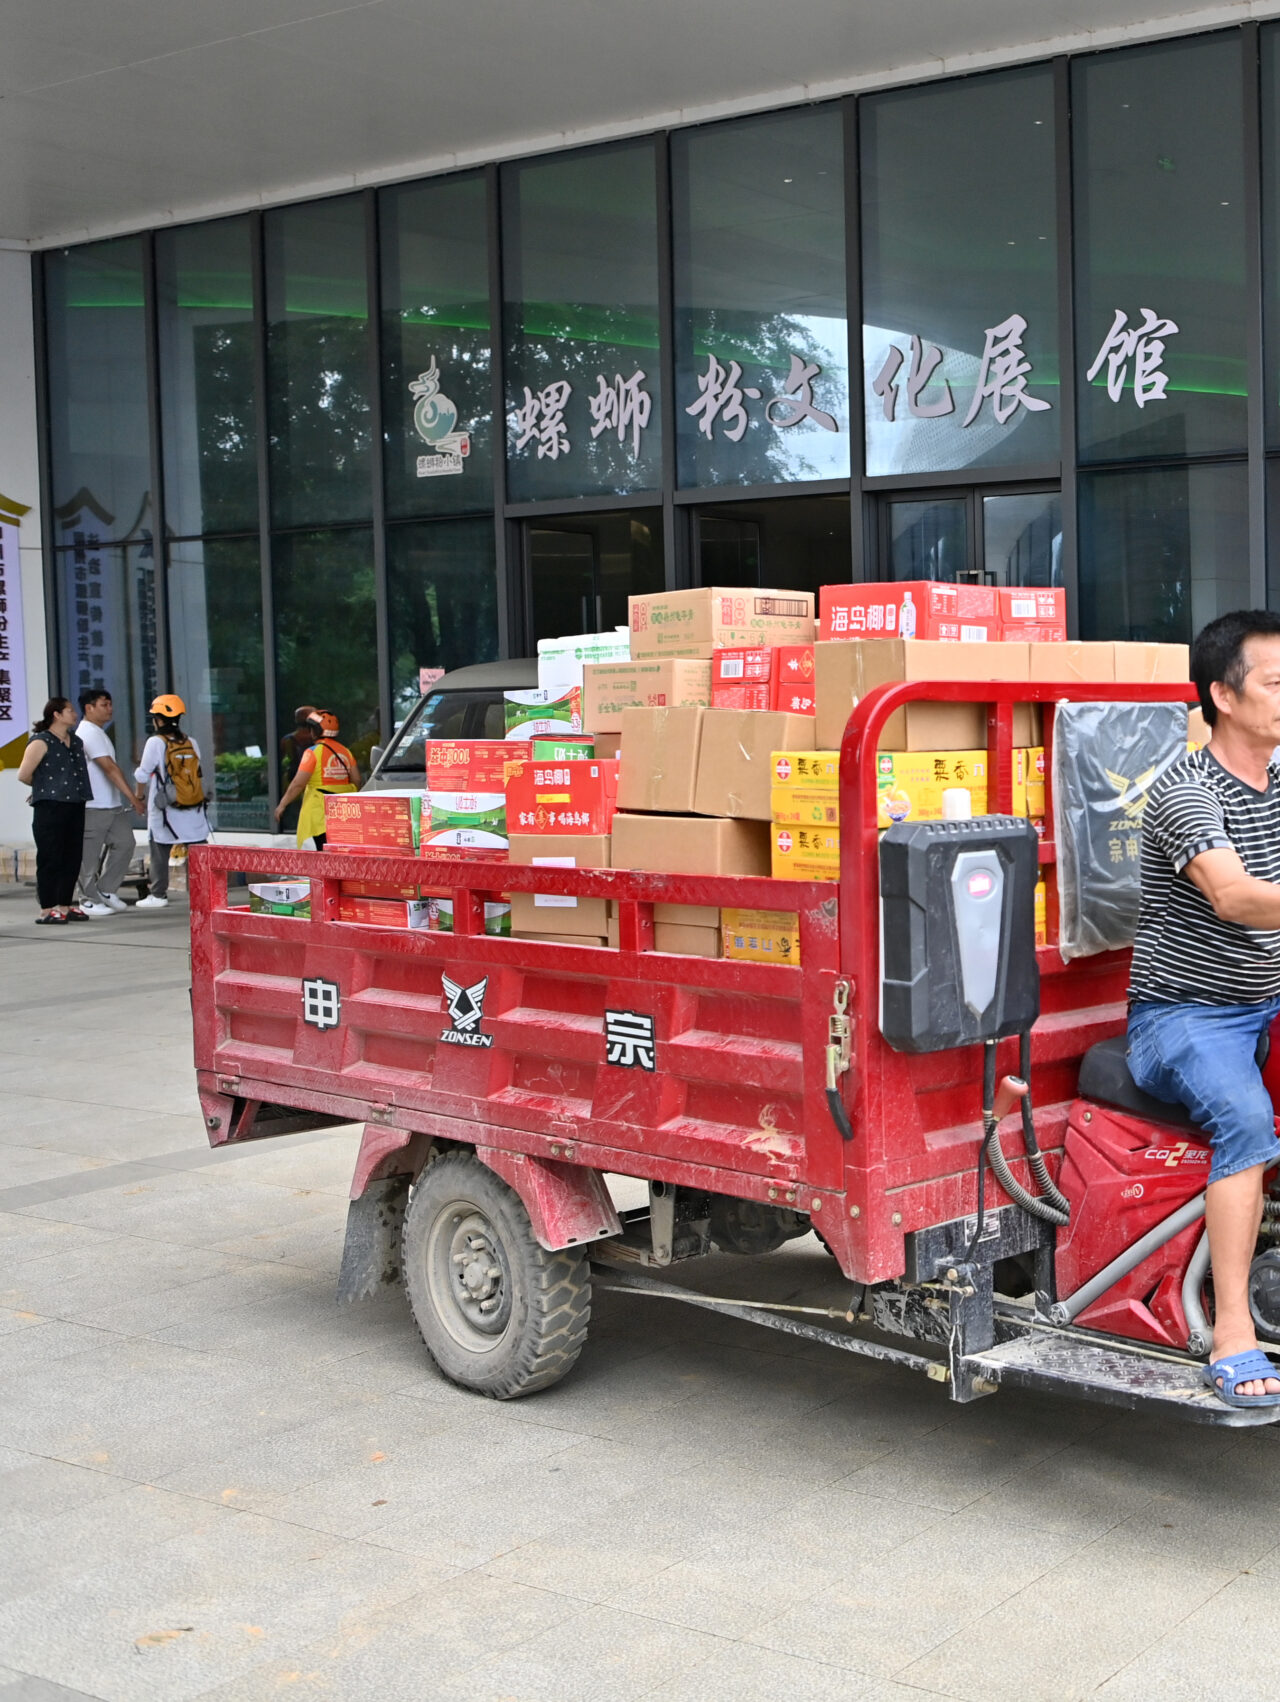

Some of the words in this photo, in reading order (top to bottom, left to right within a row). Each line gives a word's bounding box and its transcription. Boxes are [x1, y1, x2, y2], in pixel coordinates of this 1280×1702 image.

[516, 308, 1179, 460] 螺蛳粉文化展馆
[831, 606, 884, 631] 海岛椰
[1108, 836, 1139, 864] 宗申
[304, 979, 339, 1030] 申
[441, 1029, 493, 1047] ZONSEN
[605, 1011, 655, 1068] 宗
